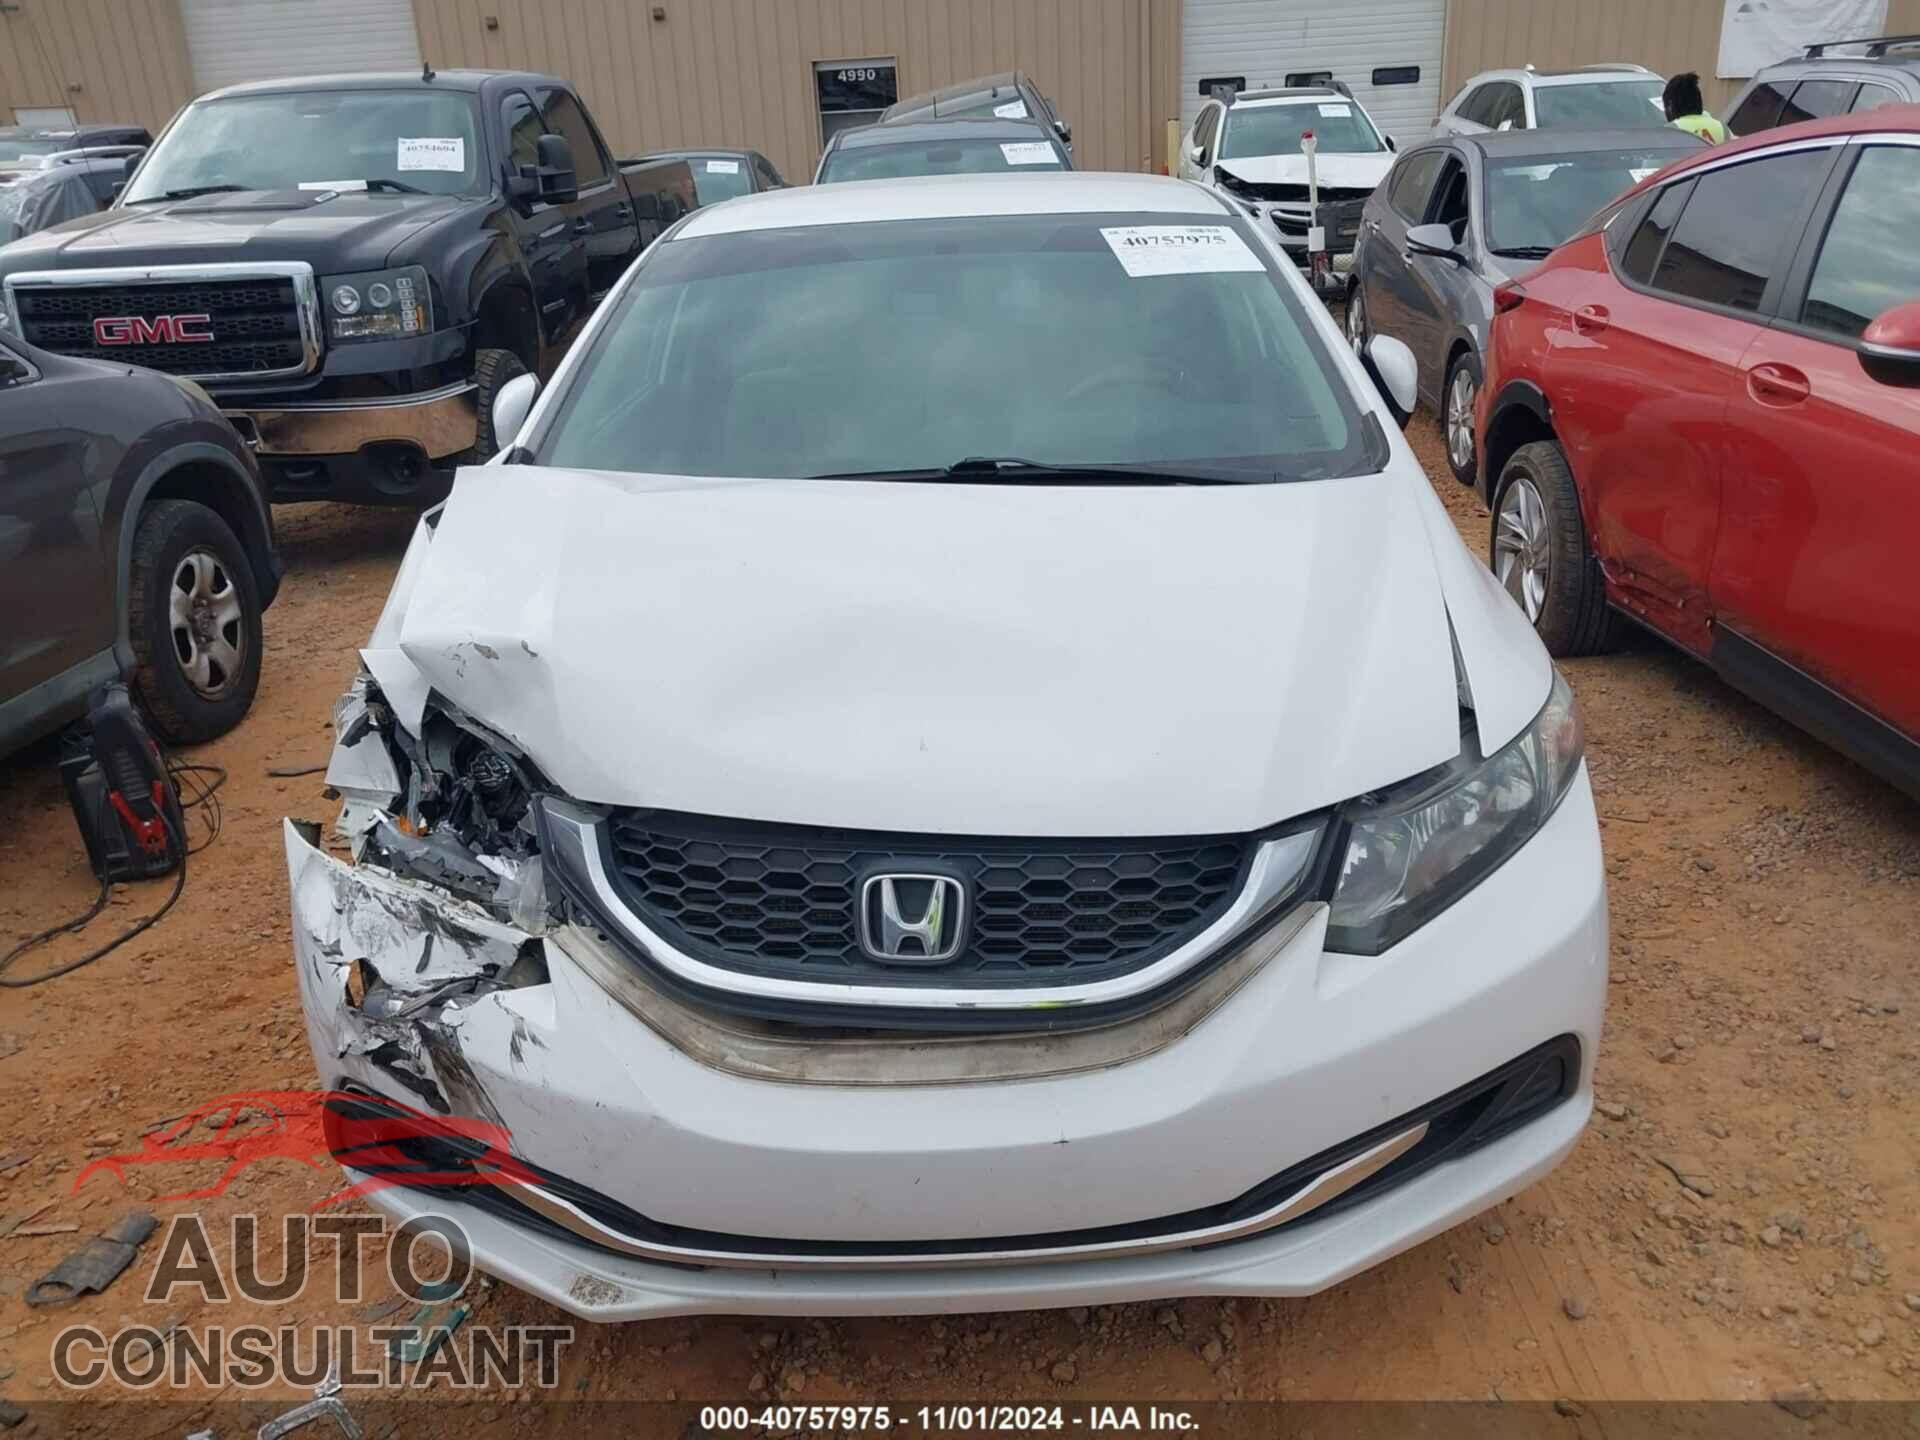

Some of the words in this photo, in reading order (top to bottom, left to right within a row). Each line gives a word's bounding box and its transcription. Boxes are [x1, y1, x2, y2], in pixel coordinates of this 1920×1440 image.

[837, 69, 876, 82] 4990
[1122, 235, 1227, 247] 40757975
[93, 314, 214, 345] GMC
